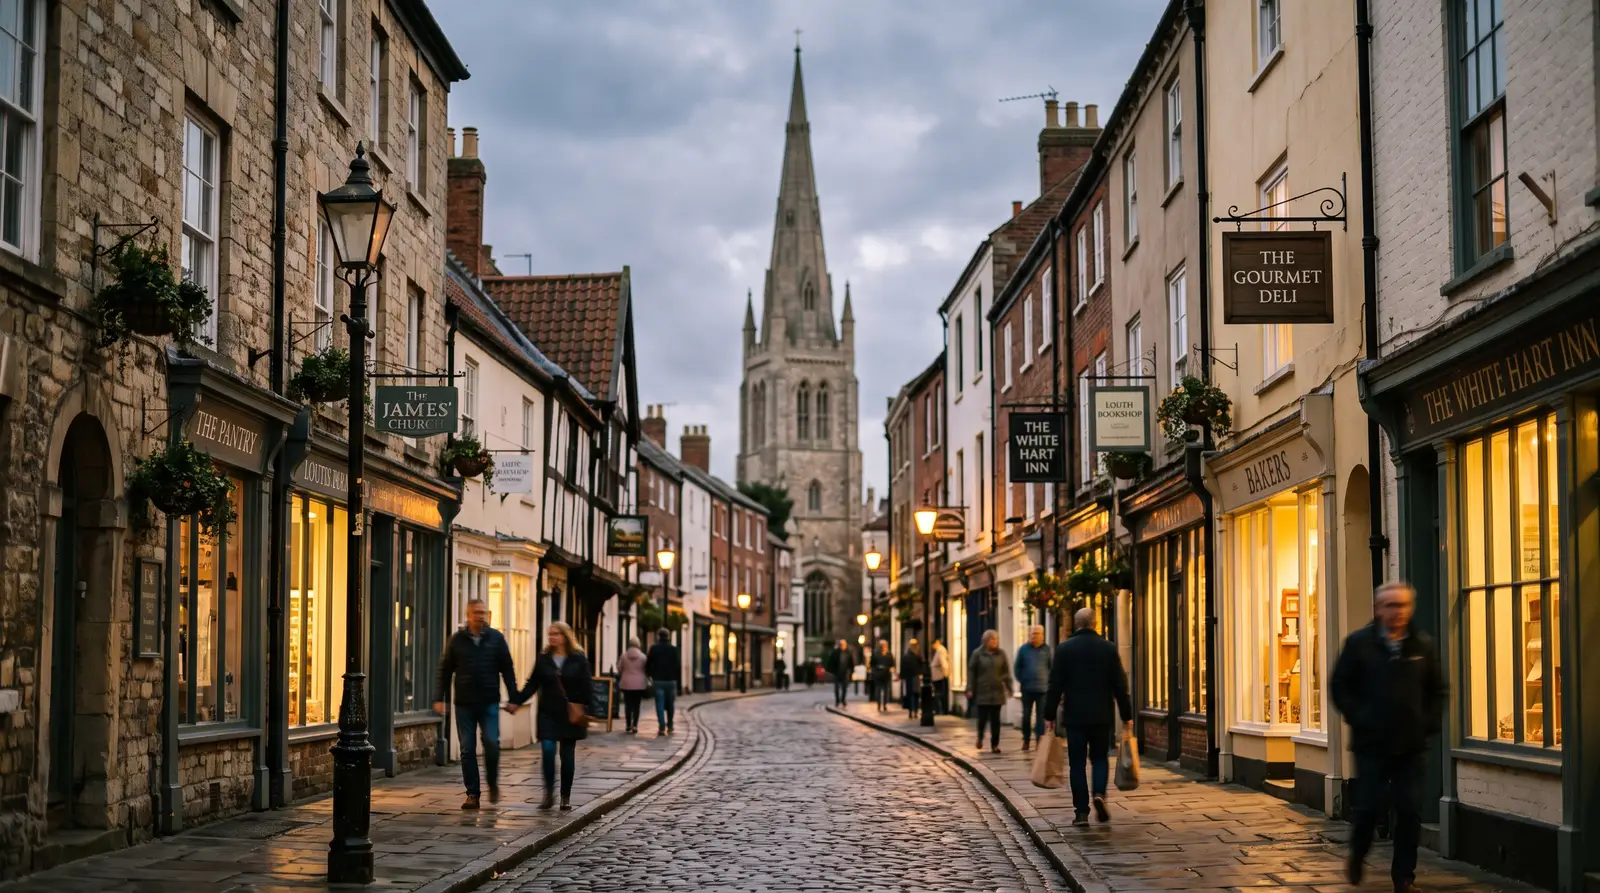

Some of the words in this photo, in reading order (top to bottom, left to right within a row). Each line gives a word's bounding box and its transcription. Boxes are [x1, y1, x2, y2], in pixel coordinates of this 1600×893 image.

[1260, 251, 1295, 265] THE
[1233, 270, 1322, 284] GOURMET
[1259, 289, 1297, 303] DELI
[1423, 385, 1453, 424] THE
[1453, 362, 1505, 413] WHITE
[1506, 338, 1555, 392] HART
[1559, 319, 1600, 371] INN
[382, 401, 452, 418] JAMES'
[1105, 401, 1134, 409] LOUTH
[1098, 410, 1142, 418] BOOKSHOP
[196, 410, 218, 440] THE
[218, 420, 258, 455] PANTRY
[1024, 421, 1050, 433] THE
[1015, 434, 1059, 446] WHITE
[1020, 448, 1055, 460] HART
[1025, 462, 1049, 473] INN
[1245, 450, 1291, 494] BAKERS
